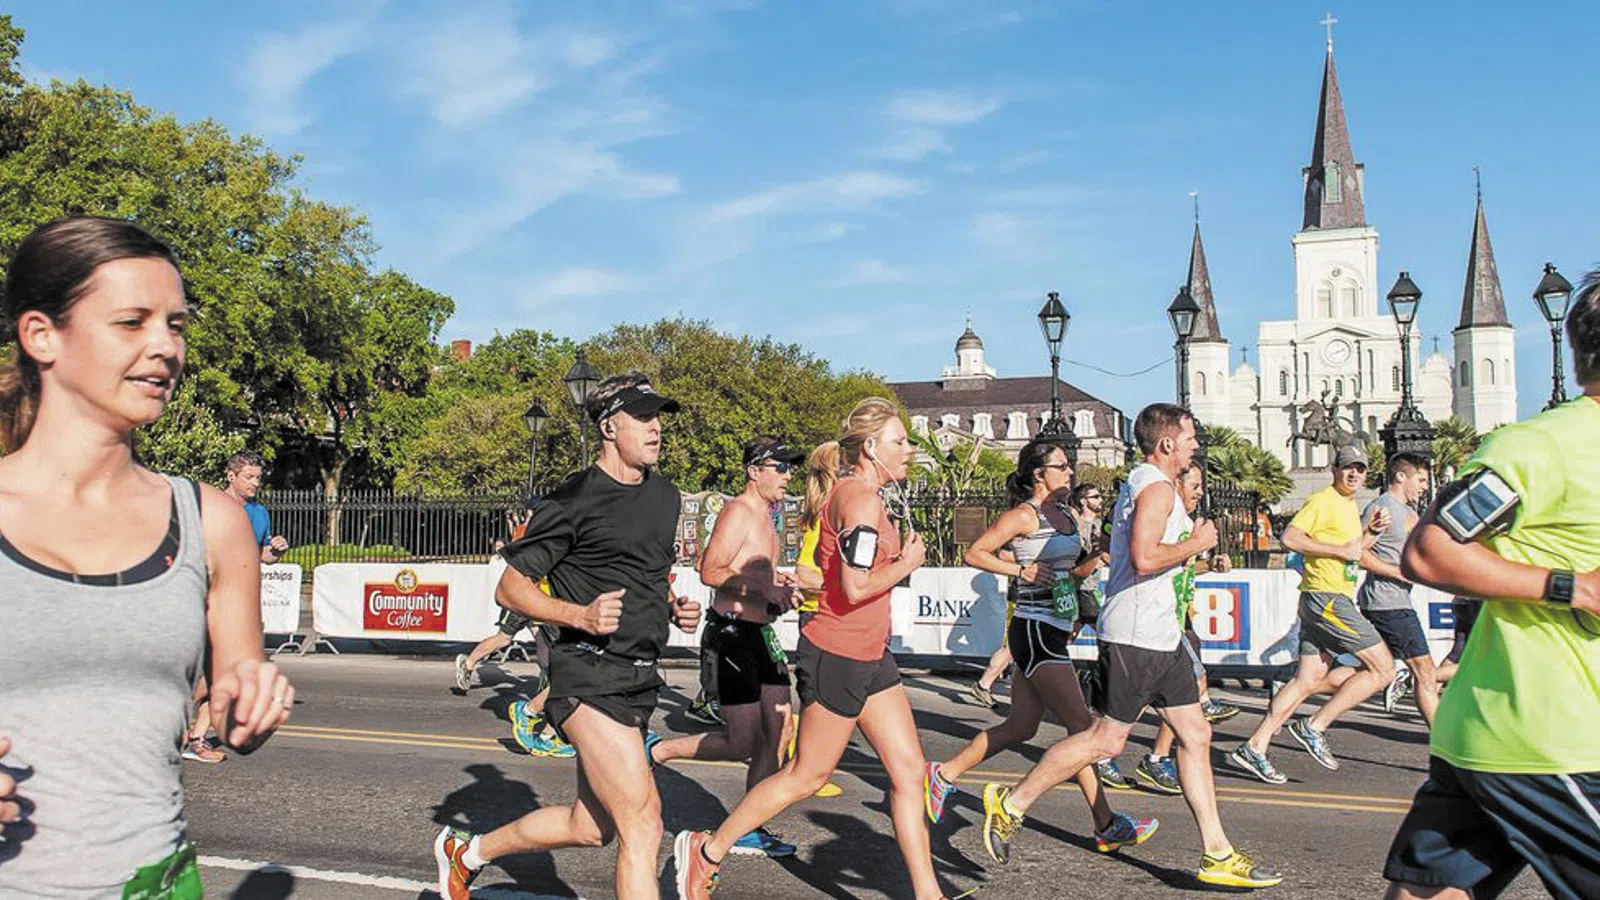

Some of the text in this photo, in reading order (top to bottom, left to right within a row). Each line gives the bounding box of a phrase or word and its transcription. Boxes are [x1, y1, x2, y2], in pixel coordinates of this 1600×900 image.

[369, 590, 444, 616] Community
[918, 595, 972, 618] BANK
[387, 610, 423, 629] Coffee
